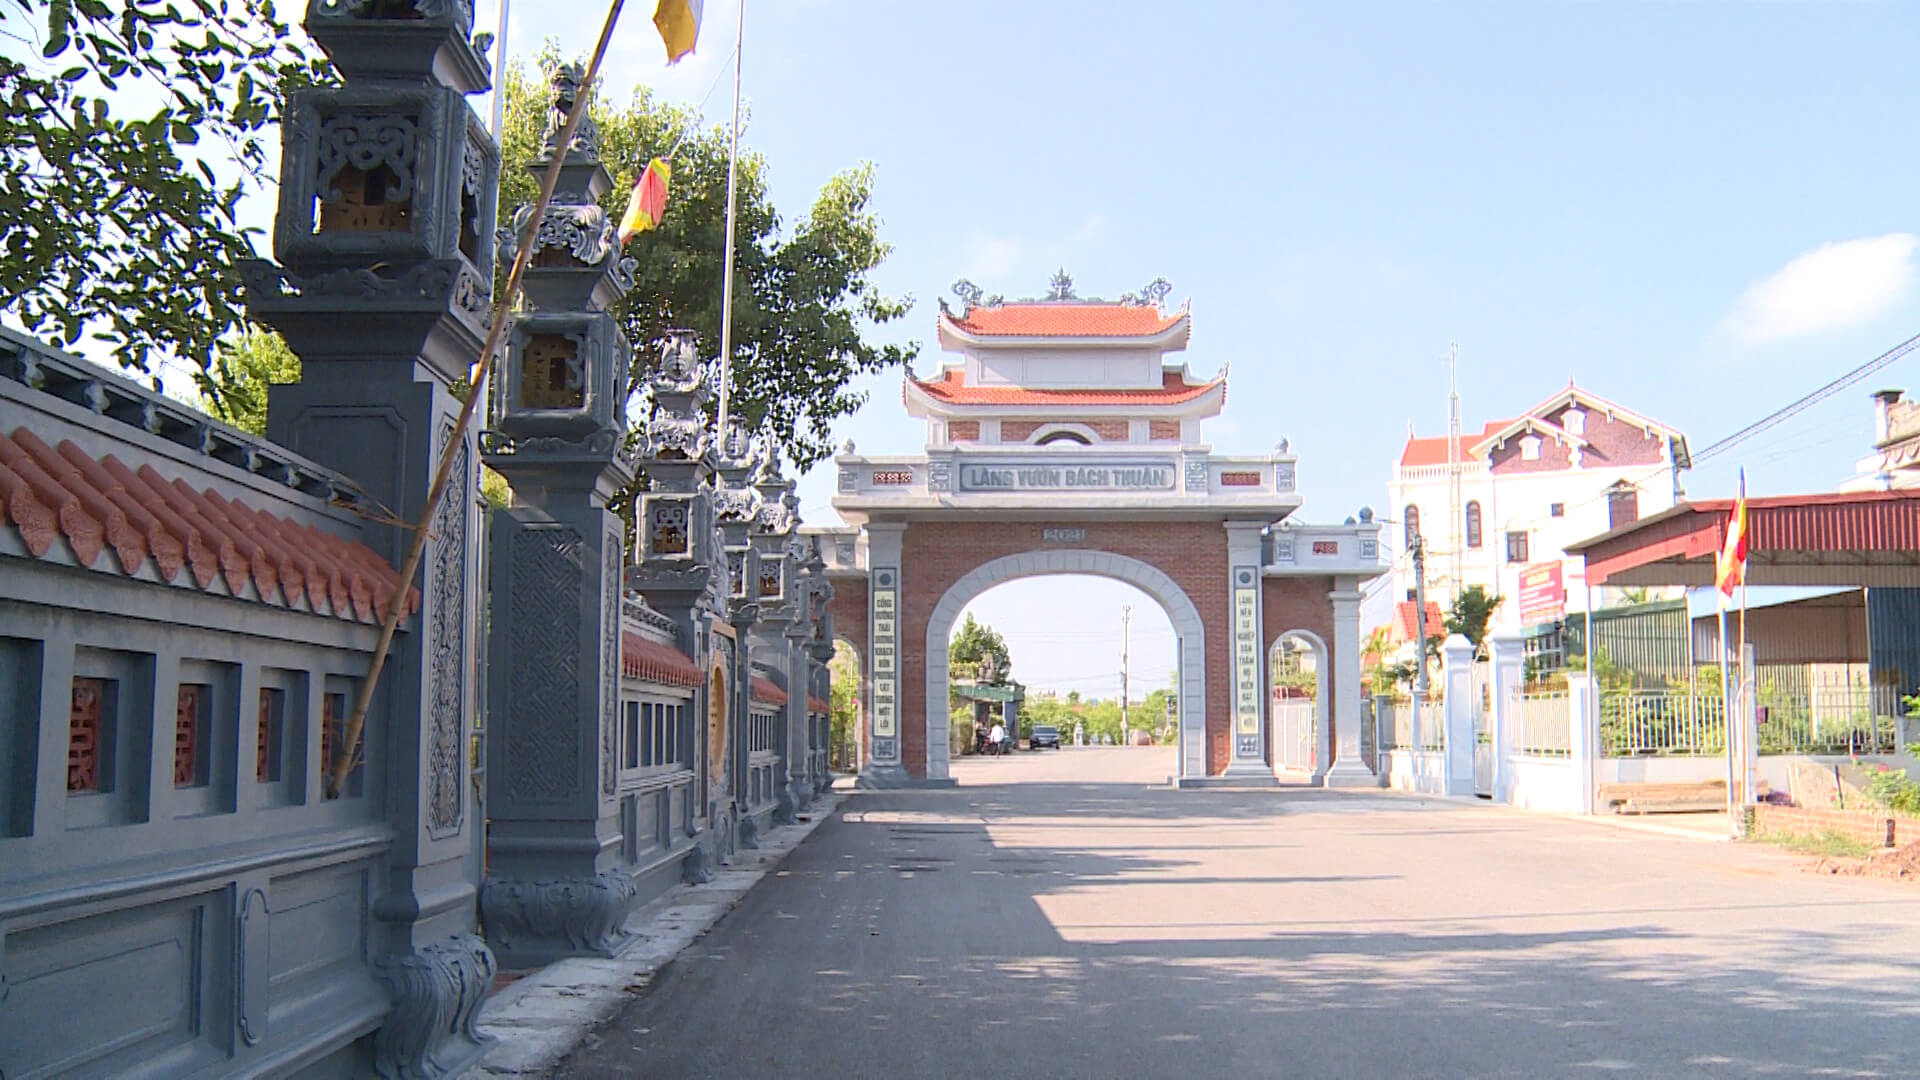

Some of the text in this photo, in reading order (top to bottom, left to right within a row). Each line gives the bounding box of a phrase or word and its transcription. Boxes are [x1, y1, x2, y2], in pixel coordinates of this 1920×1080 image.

[971, 467, 1165, 490] LÀNG VƯỜN BÁCH THUẬN
